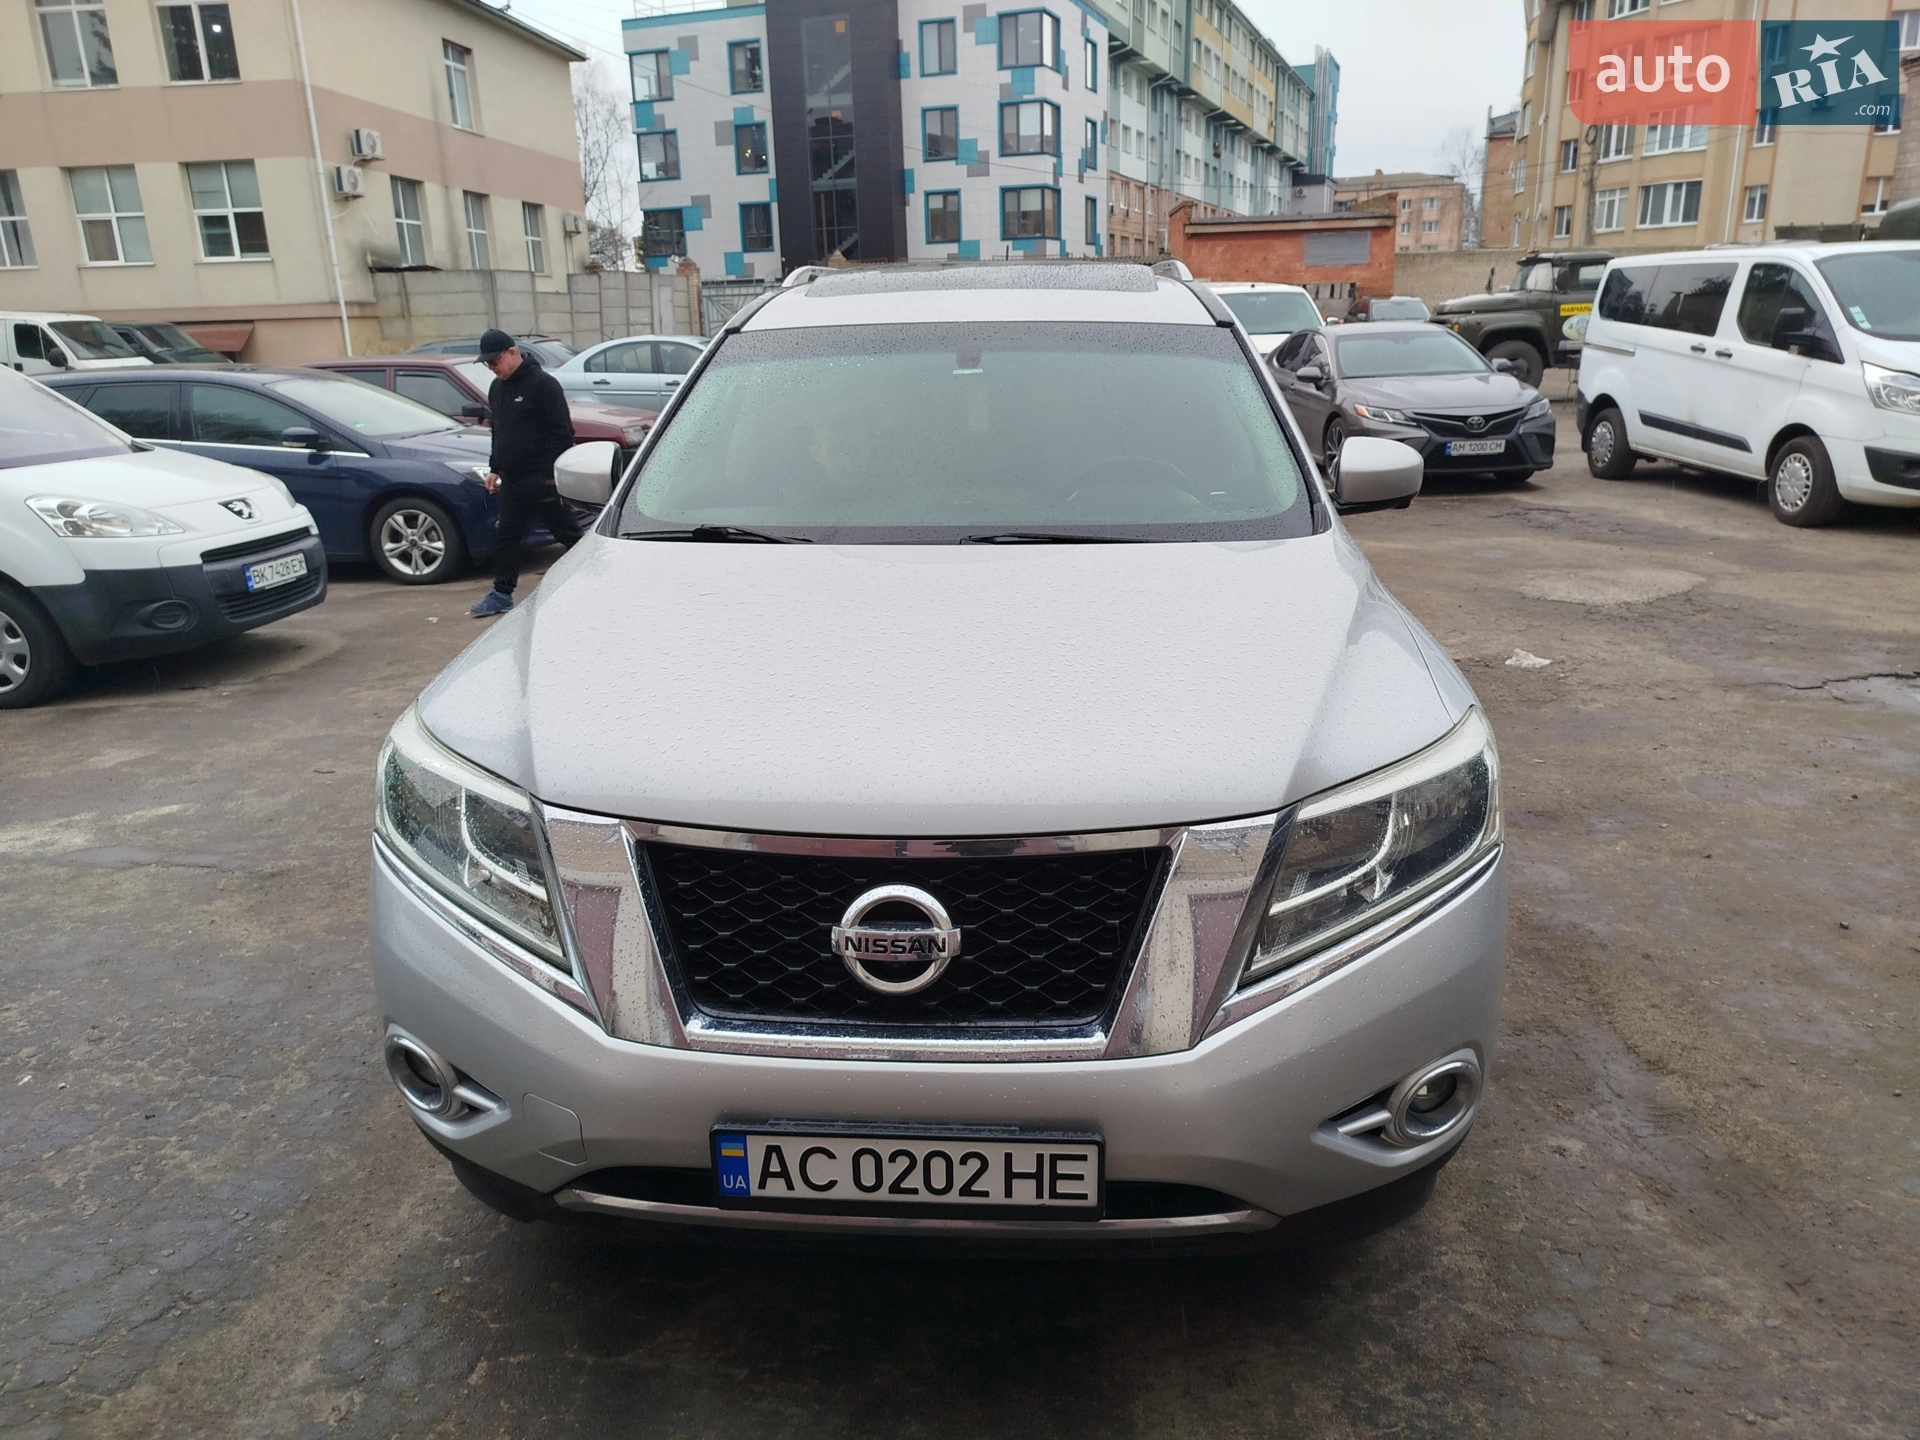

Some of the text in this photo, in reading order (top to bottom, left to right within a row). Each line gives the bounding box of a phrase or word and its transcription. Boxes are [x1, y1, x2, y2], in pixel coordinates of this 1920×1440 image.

[1451, 442, 1466, 452] AM
[1468, 442, 1488, 452] 1200
[252, 566, 269, 585] BK
[268, 561, 291, 580] 7428
[844, 935, 947, 954] NISSAN
[722, 1174, 747, 1190] UA
[757, 1144, 1089, 1201] AC 0202 HE
